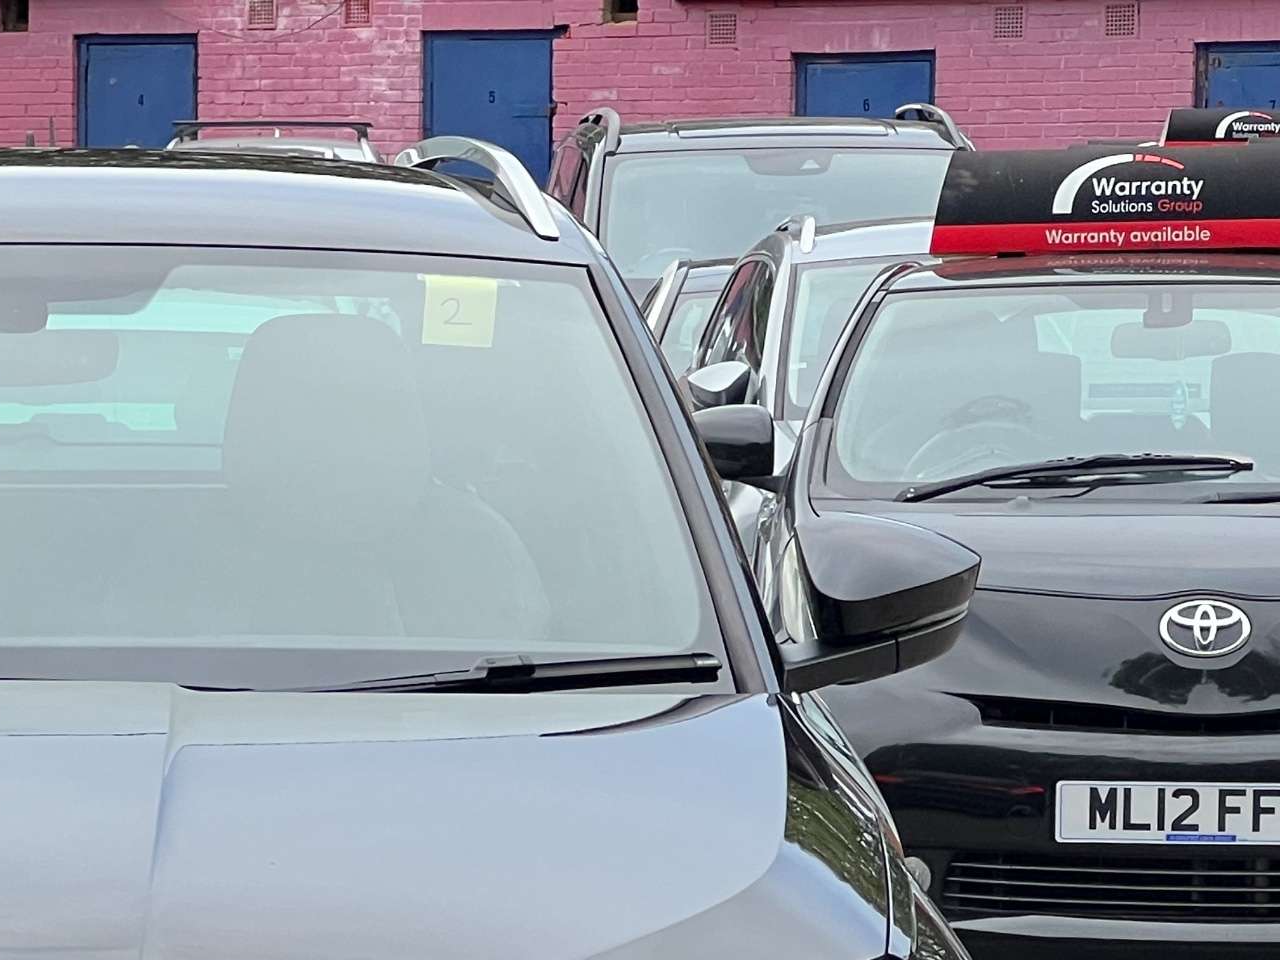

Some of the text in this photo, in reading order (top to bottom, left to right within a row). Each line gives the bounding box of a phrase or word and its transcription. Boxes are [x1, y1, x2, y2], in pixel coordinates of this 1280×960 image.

[863, 98, 870, 112] 6
[1232, 121, 1280, 133] Warranty
[1092, 177, 1204, 200] Warranty
[1091, 200, 1203, 214] Solutions Group
[1045, 226, 1211, 247] Warranty available
[440, 297, 473, 326] 2
